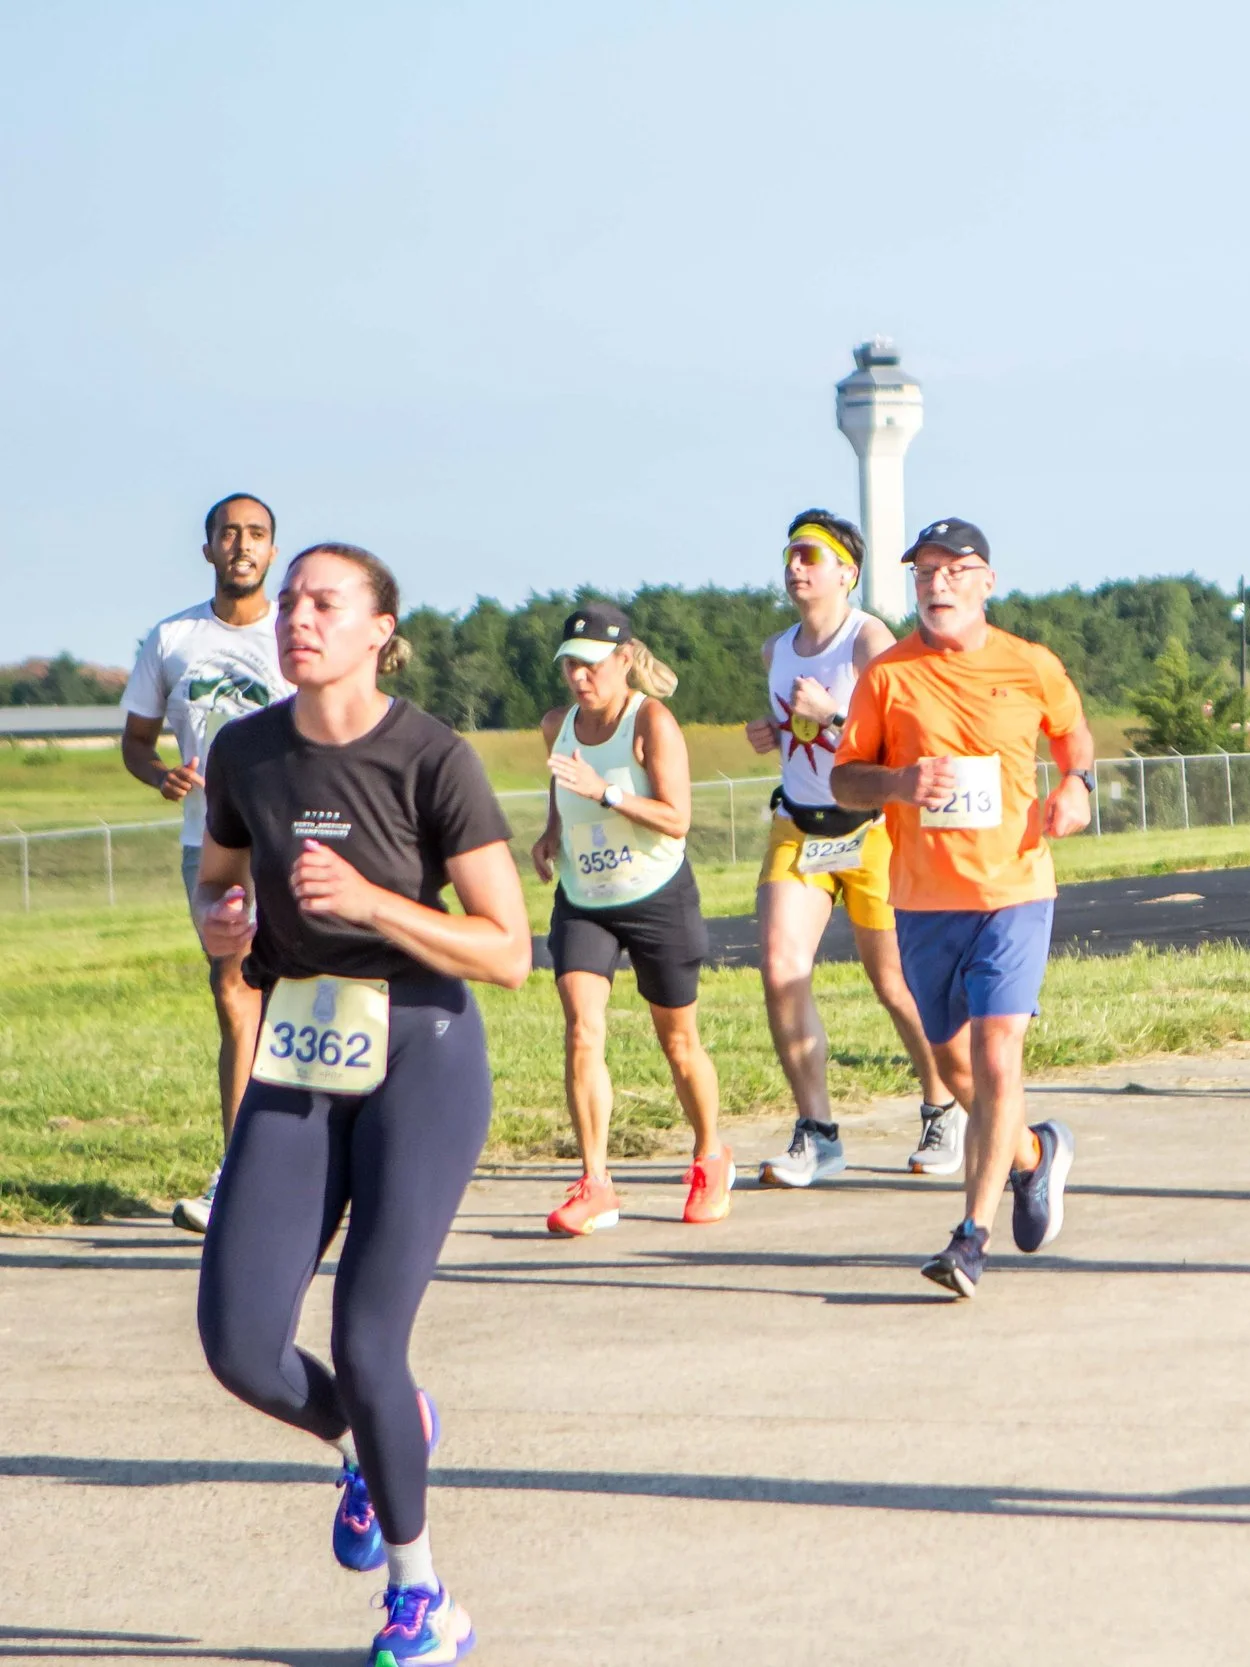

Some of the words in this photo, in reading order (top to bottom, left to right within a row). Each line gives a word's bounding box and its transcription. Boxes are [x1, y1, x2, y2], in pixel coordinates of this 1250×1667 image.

[926, 790, 992, 813] 213
[579, 845, 632, 874] 3534
[806, 840, 860, 858] 3232
[270, 1021, 372, 1068] 3362
